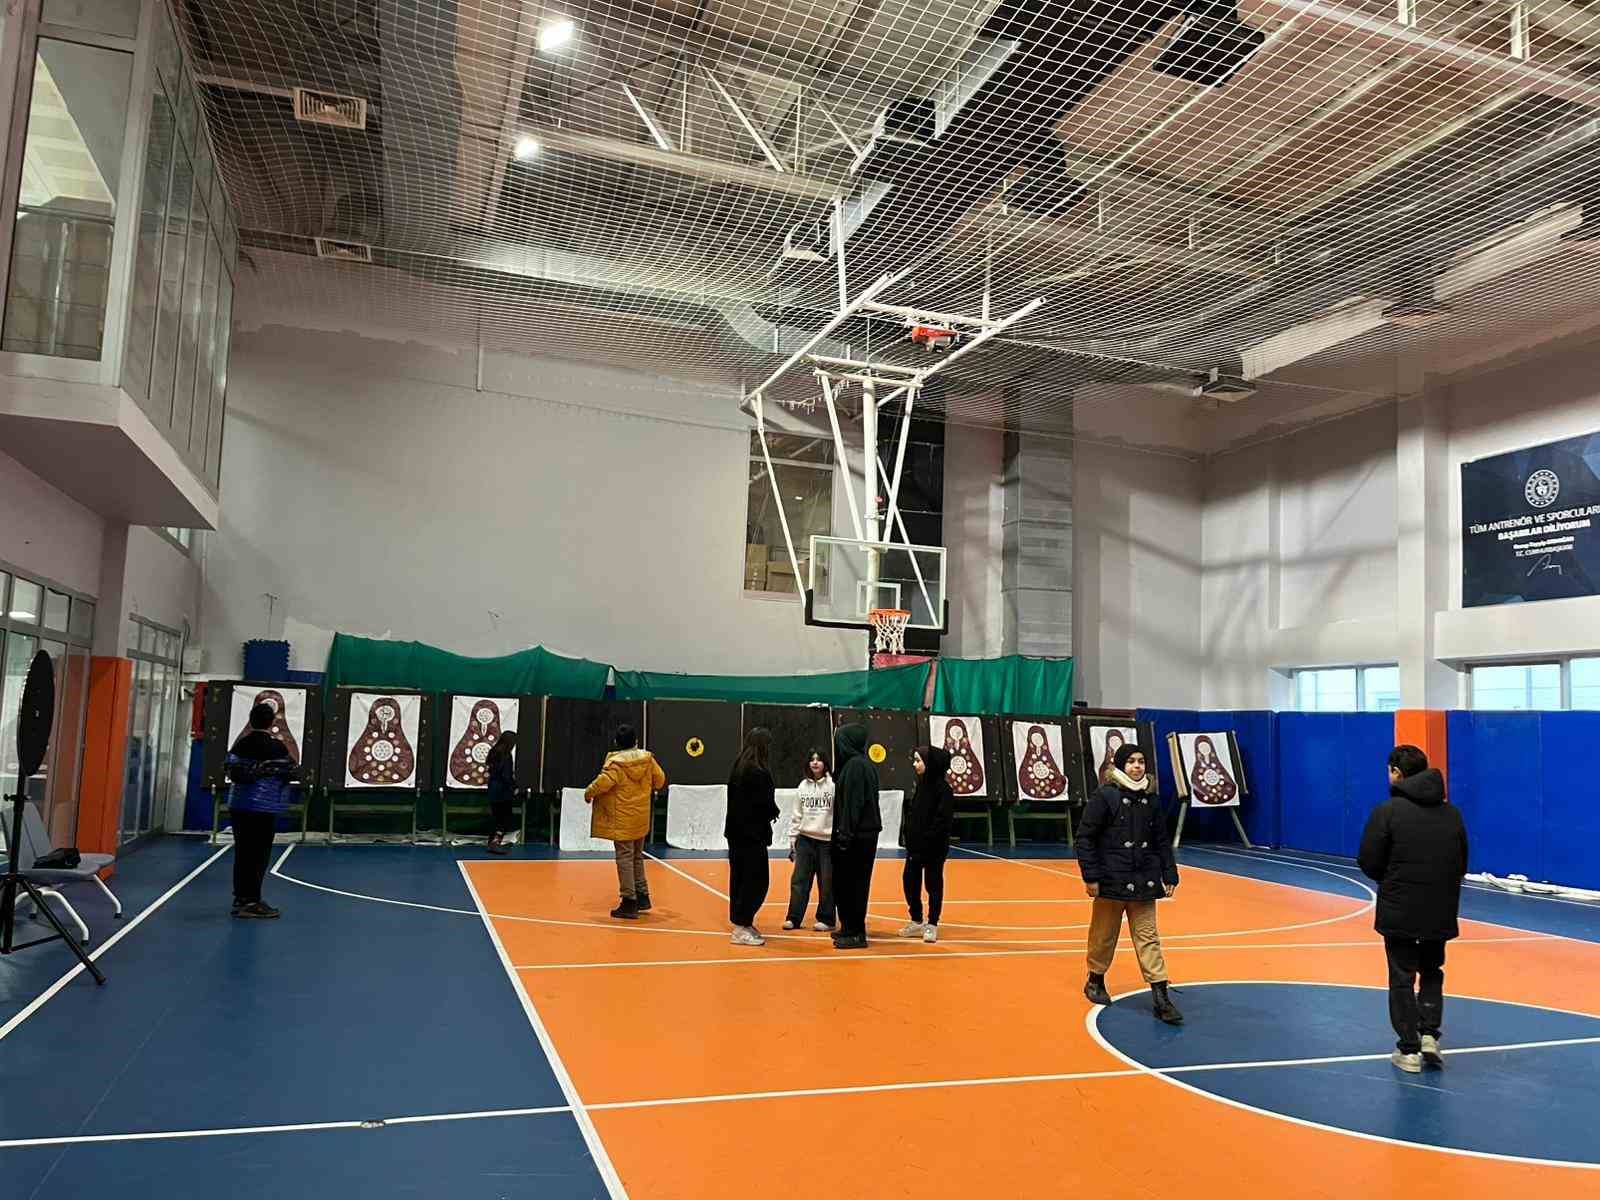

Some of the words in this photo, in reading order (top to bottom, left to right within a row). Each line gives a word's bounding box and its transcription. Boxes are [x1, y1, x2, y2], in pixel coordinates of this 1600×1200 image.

[1469, 523, 1487, 535] TÜM
[1488, 516, 1533, 530] ANTRENÖR
[1534, 513, 1546, 524] VE
